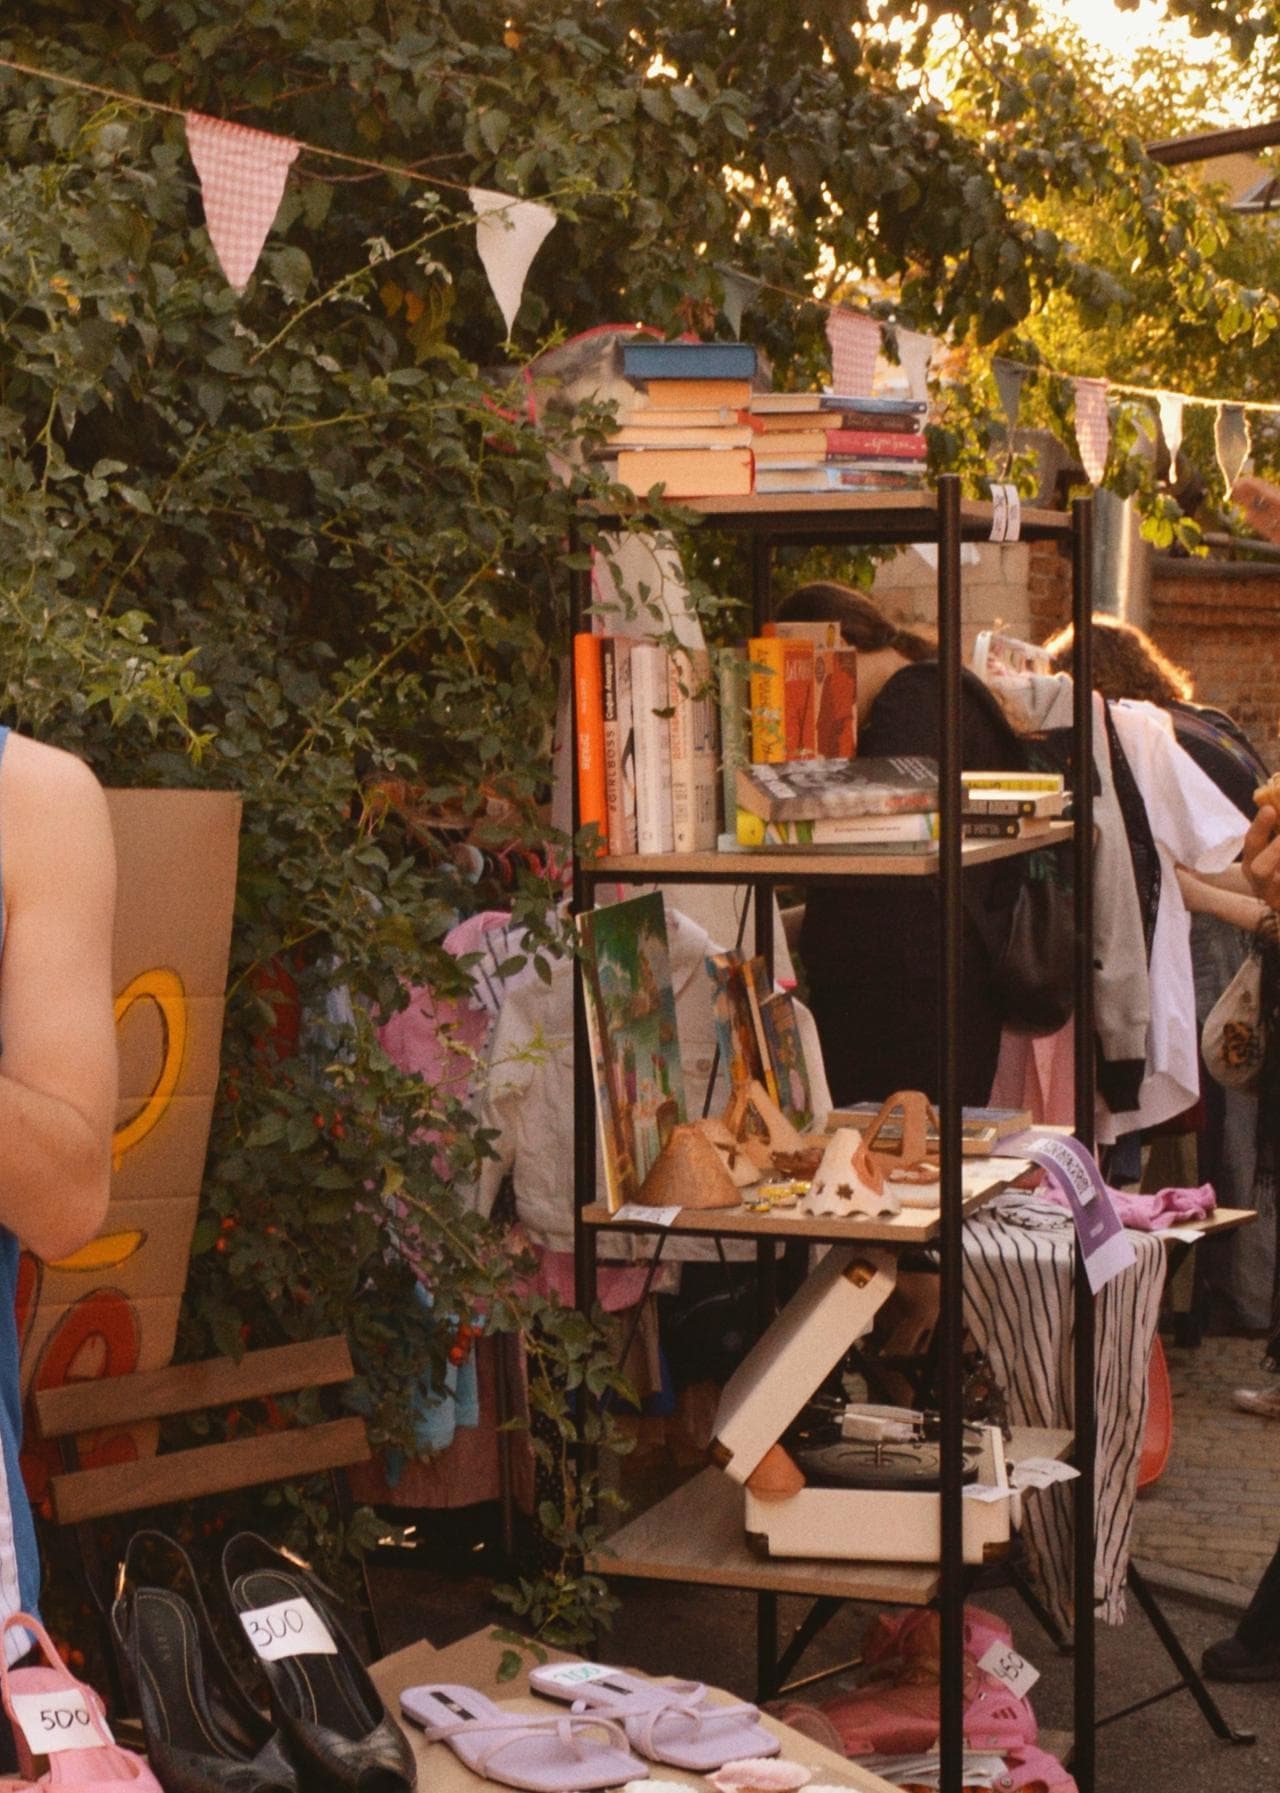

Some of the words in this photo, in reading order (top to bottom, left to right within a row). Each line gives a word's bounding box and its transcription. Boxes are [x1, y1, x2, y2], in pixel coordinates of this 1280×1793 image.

[606, 729, 617, 813] #GIRLBOSS
[249, 1607, 304, 1647] 300
[992, 1651, 1024, 1682] 450
[40, 1708, 91, 1731] 500
